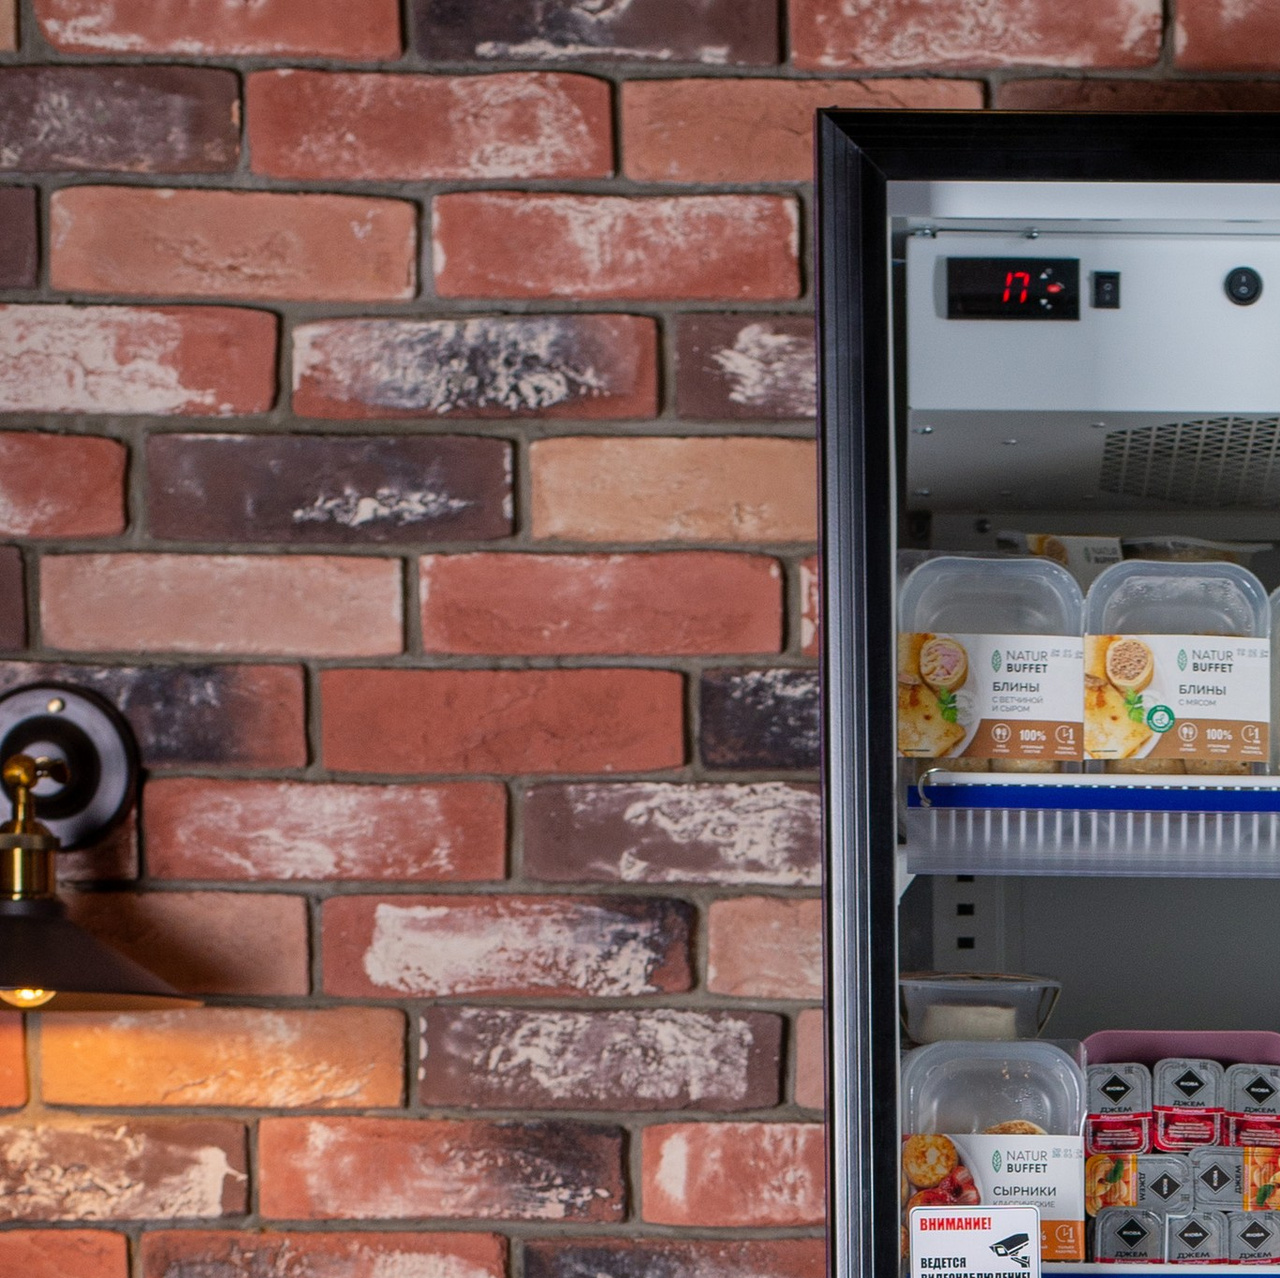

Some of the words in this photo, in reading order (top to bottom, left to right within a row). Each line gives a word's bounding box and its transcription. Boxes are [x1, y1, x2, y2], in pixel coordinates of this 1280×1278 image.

[1006, 650, 1048, 661] NATUR
[1192, 650, 1233, 661] NATUR
[1006, 663, 1048, 673] BUFFET
[1192, 663, 1233, 673] BUFFET
[992, 682, 1040, 692] БЛИНЫ
[1179, 684, 1227, 695] БЛИНЫ
[1019, 729, 1047, 741] 100%
[1206, 728, 1233, 740] 100%
[1243, 1106, 1277, 1114] ДЖЕМ
[1007, 1150, 1048, 1162] NATUR
[1007, 1163, 1048, 1174] BUFFET
[1234, 1164, 1242, 1194] ДЖЕМ
[993, 1186, 1056, 1197] СЫРНИКИ
[1138, 1171, 1146, 1201] ДЖЕМ
[920, 1217, 992, 1231] ВНИМАНИЕ!
[921, 1257, 966, 1270] ВЕДЕТСЯ
